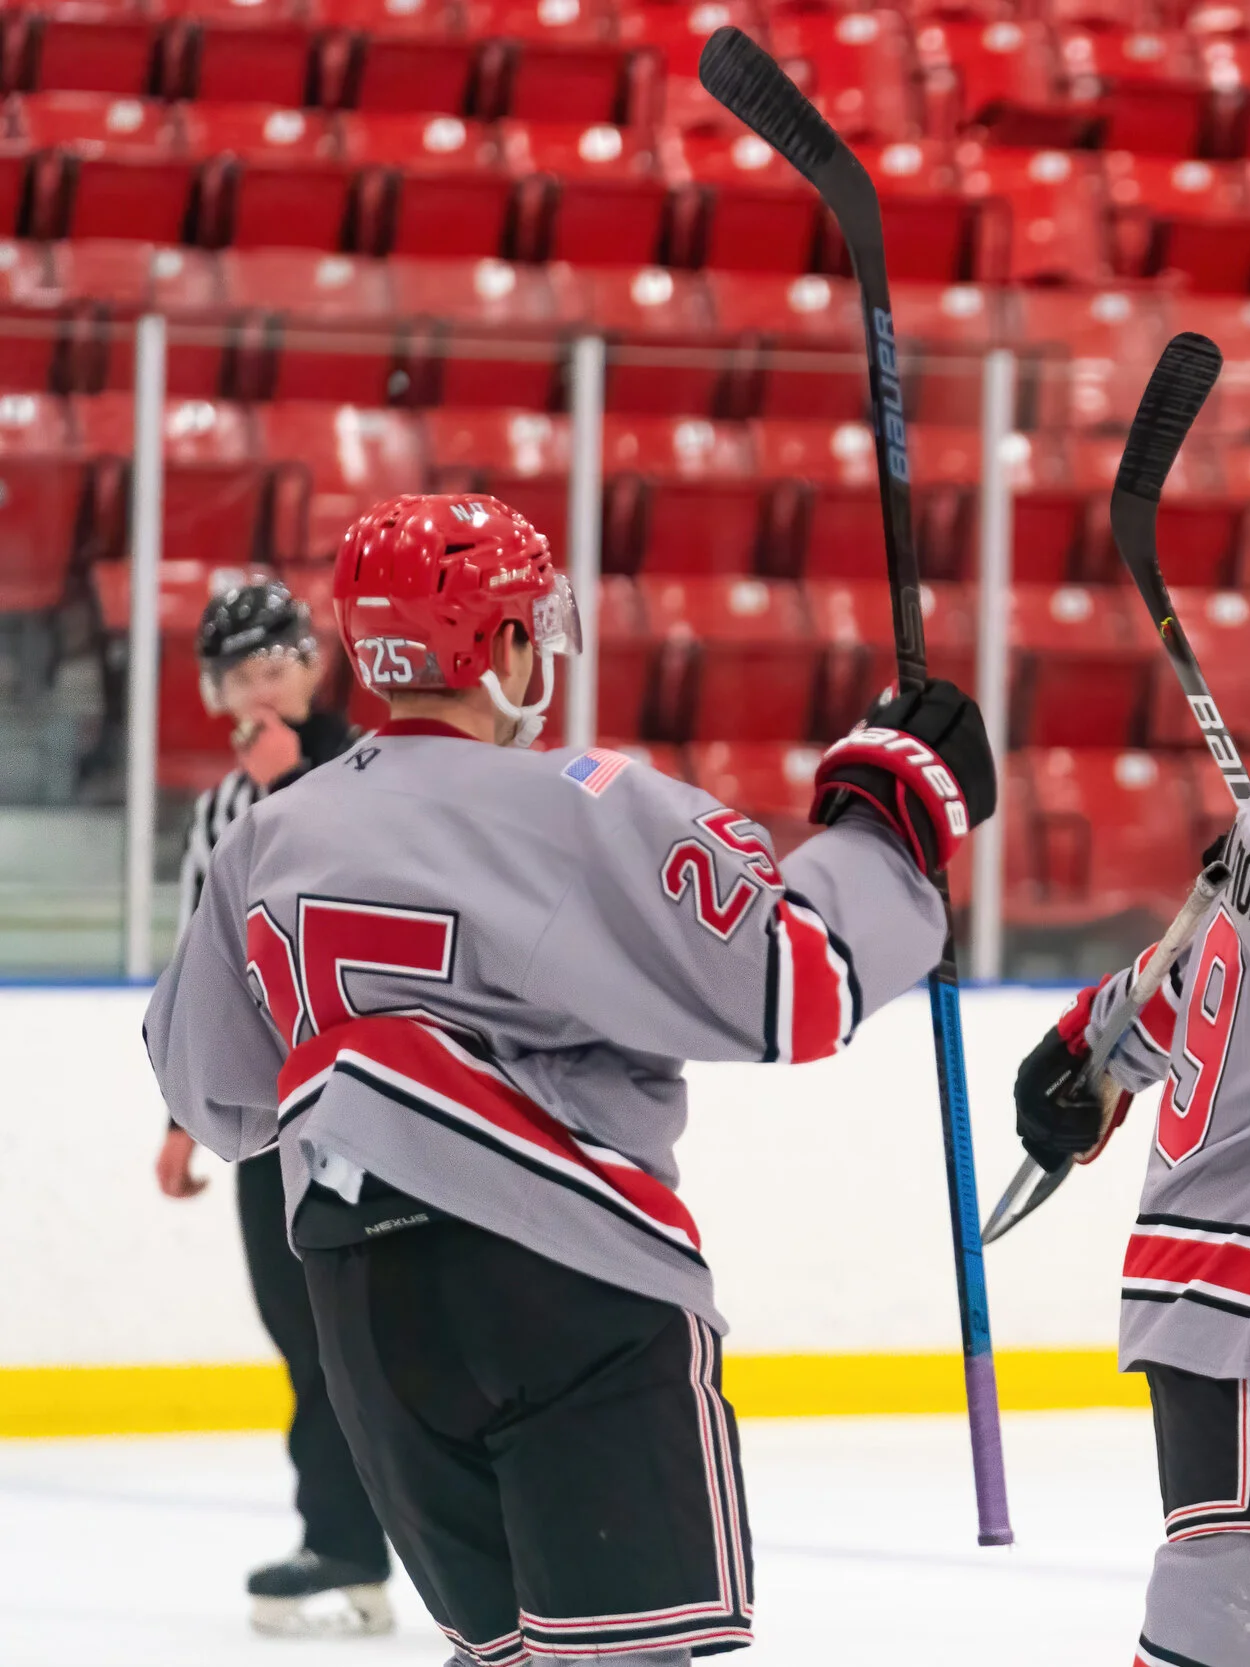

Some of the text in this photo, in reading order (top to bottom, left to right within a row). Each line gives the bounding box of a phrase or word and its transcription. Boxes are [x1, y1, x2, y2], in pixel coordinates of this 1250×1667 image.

[873, 306, 911, 484] BAUER
[364, 637, 413, 683] 25
[660, 808, 787, 944] 25
[1156, 902, 1246, 1169] 9
[365, 1213, 429, 1235] NEXUS
